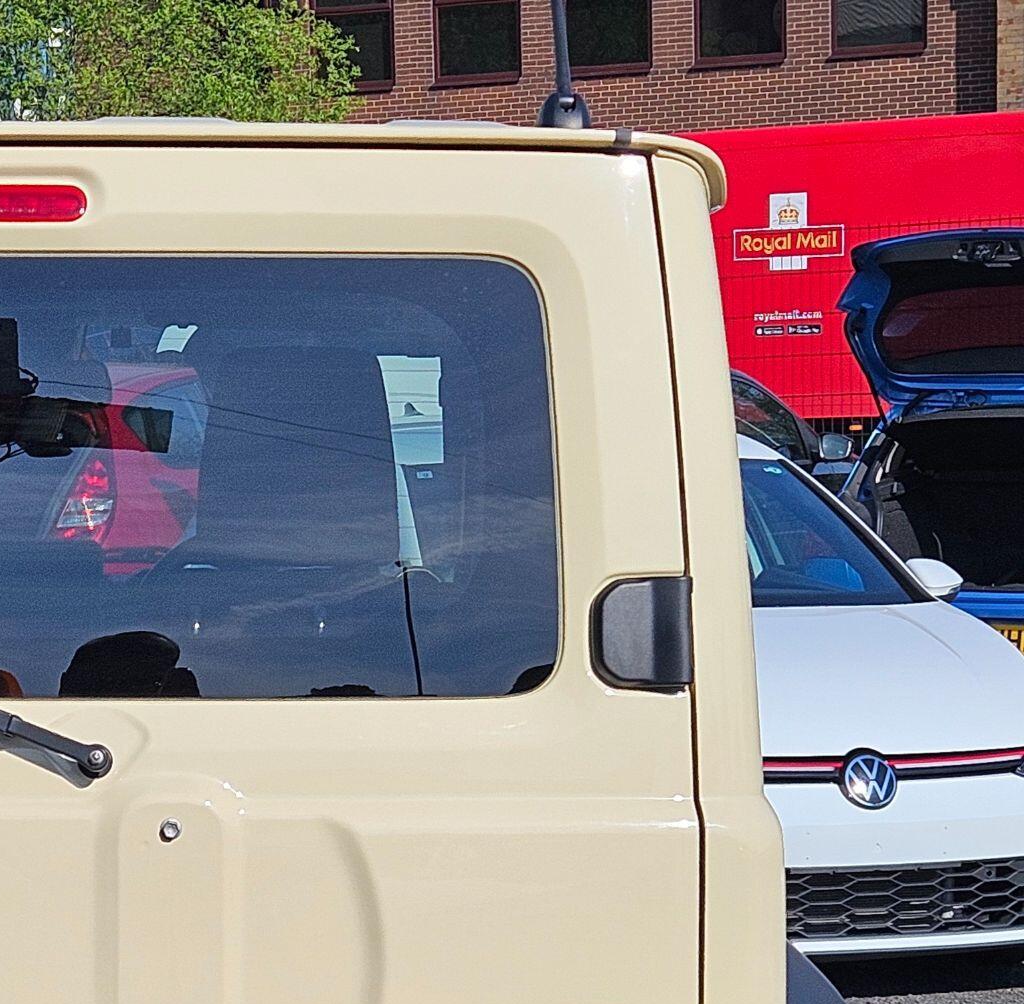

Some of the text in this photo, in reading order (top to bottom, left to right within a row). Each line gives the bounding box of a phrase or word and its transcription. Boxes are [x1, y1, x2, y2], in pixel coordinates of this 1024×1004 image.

[740, 231, 838, 255] Royal Mail
[753, 309, 823, 323] royalmail.com
